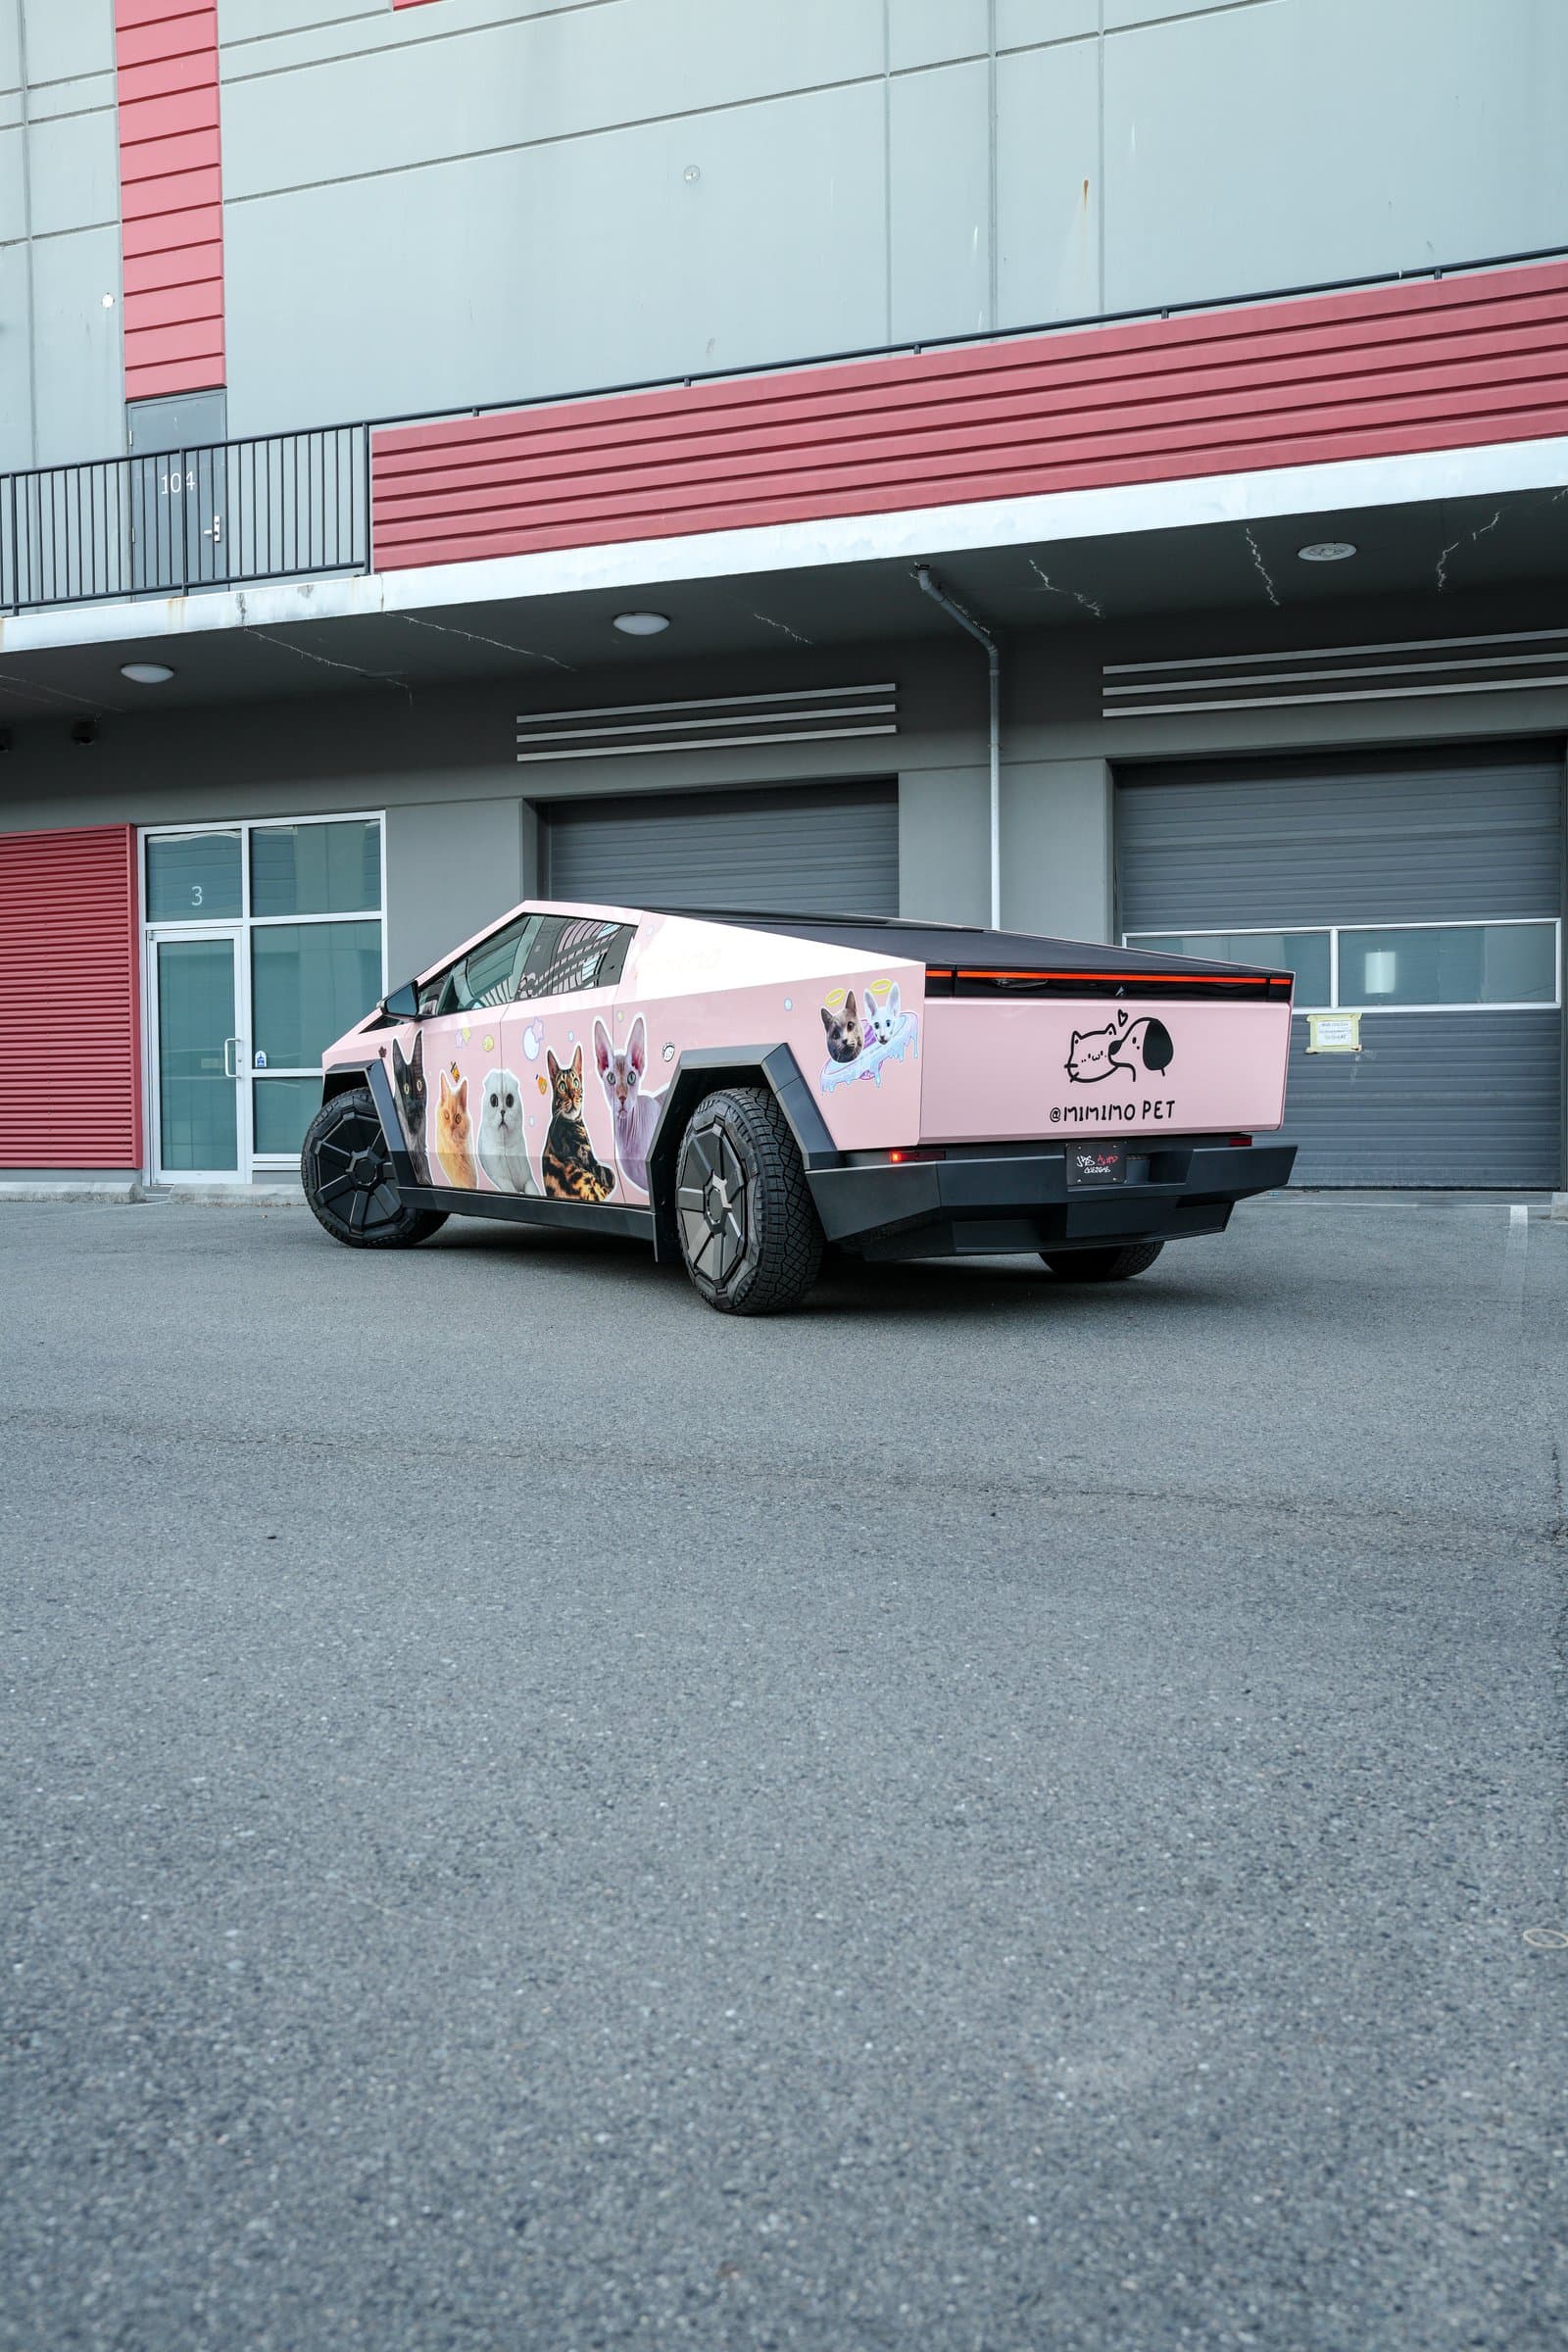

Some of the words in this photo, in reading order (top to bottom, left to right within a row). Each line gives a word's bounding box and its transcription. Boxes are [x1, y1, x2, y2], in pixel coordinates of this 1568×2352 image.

[161, 471, 196, 494] 104
[191, 885, 203, 906] 3
[1142, 1100, 1175, 1120] PET
